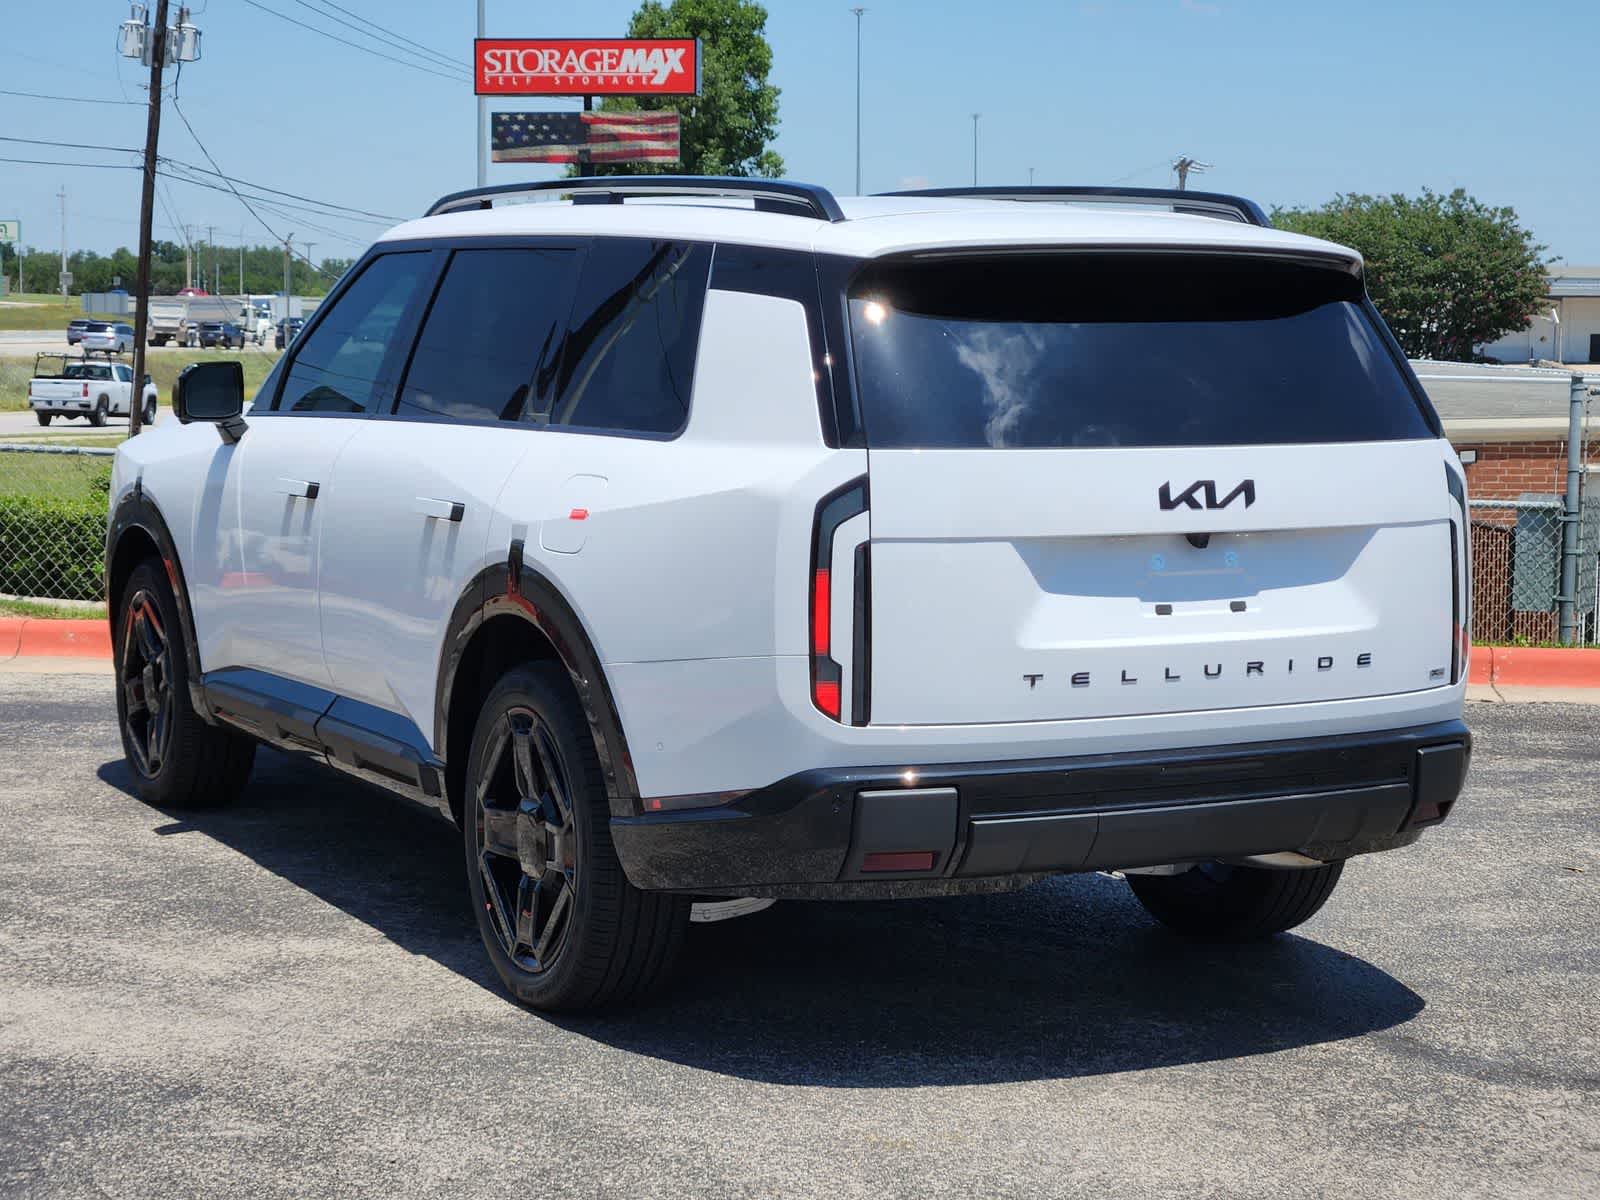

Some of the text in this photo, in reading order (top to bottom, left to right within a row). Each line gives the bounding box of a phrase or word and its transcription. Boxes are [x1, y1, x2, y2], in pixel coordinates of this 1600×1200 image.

[483, 48, 686, 85] STORAGEMAX
[484, 75, 649, 86] SELF STORAGE
[1157, 479, 1257, 511] KIA
[1022, 652, 1373, 689] TELLURIDE
